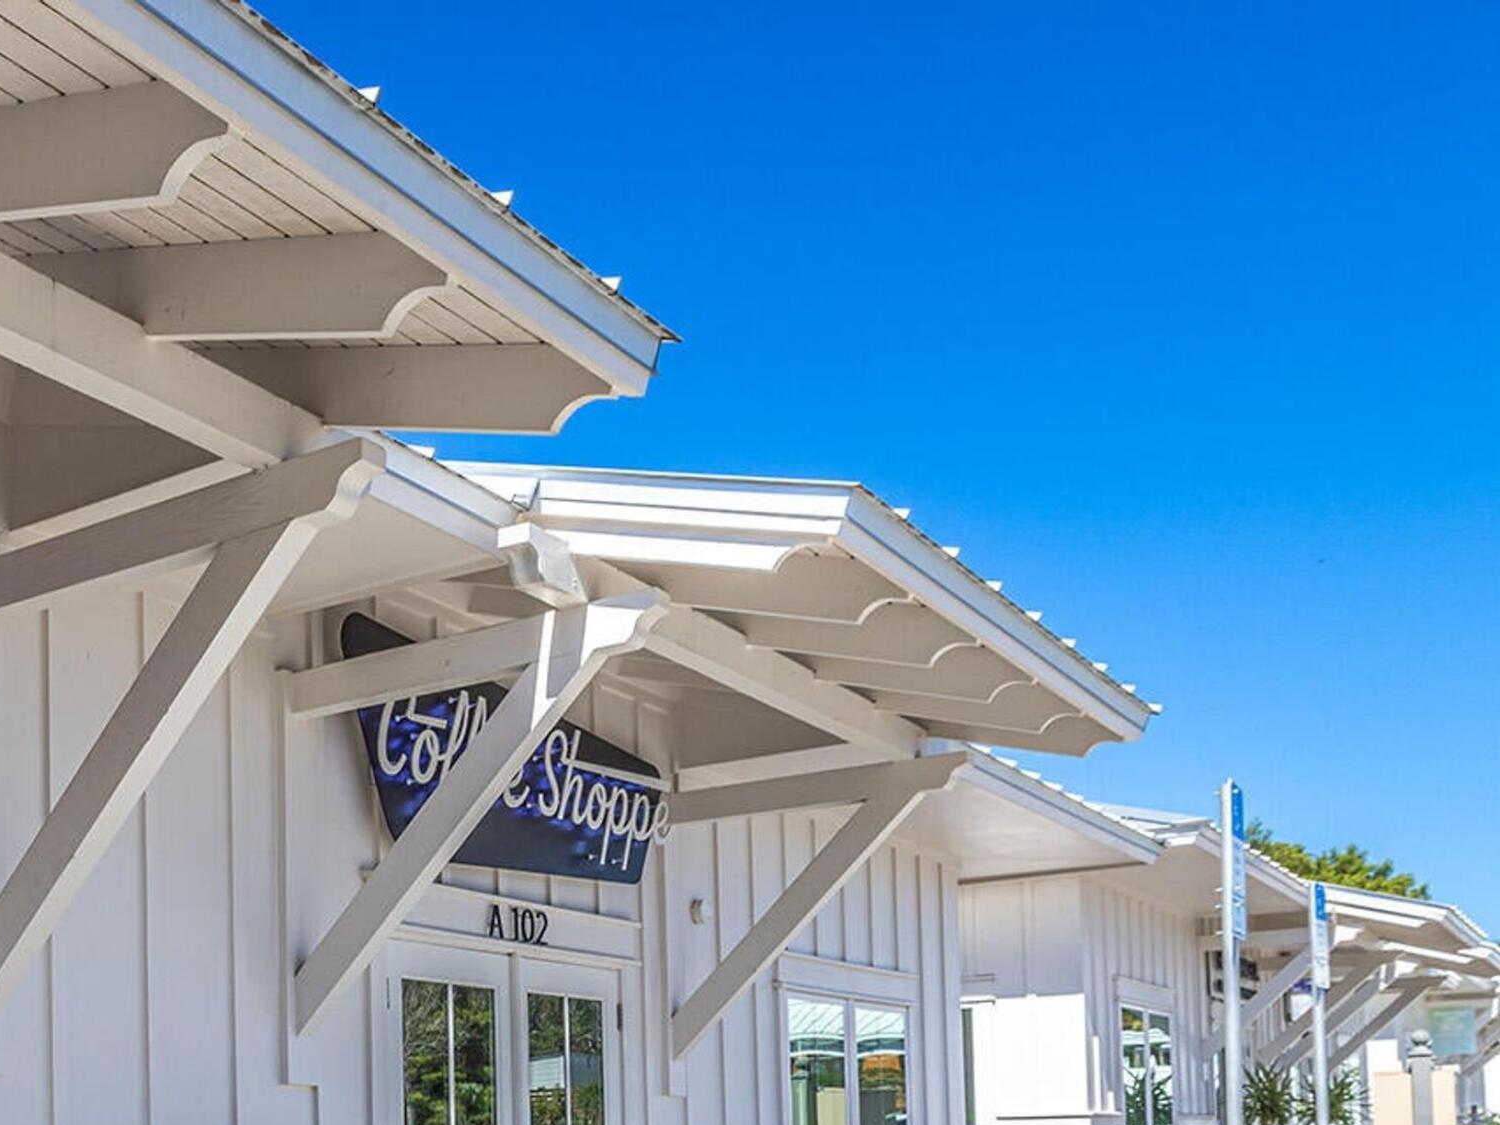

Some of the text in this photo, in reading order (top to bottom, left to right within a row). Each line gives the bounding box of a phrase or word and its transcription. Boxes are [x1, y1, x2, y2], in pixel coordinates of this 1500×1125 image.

[538, 729, 672, 871] Shoppe
[488, 904, 548, 945] A 102
